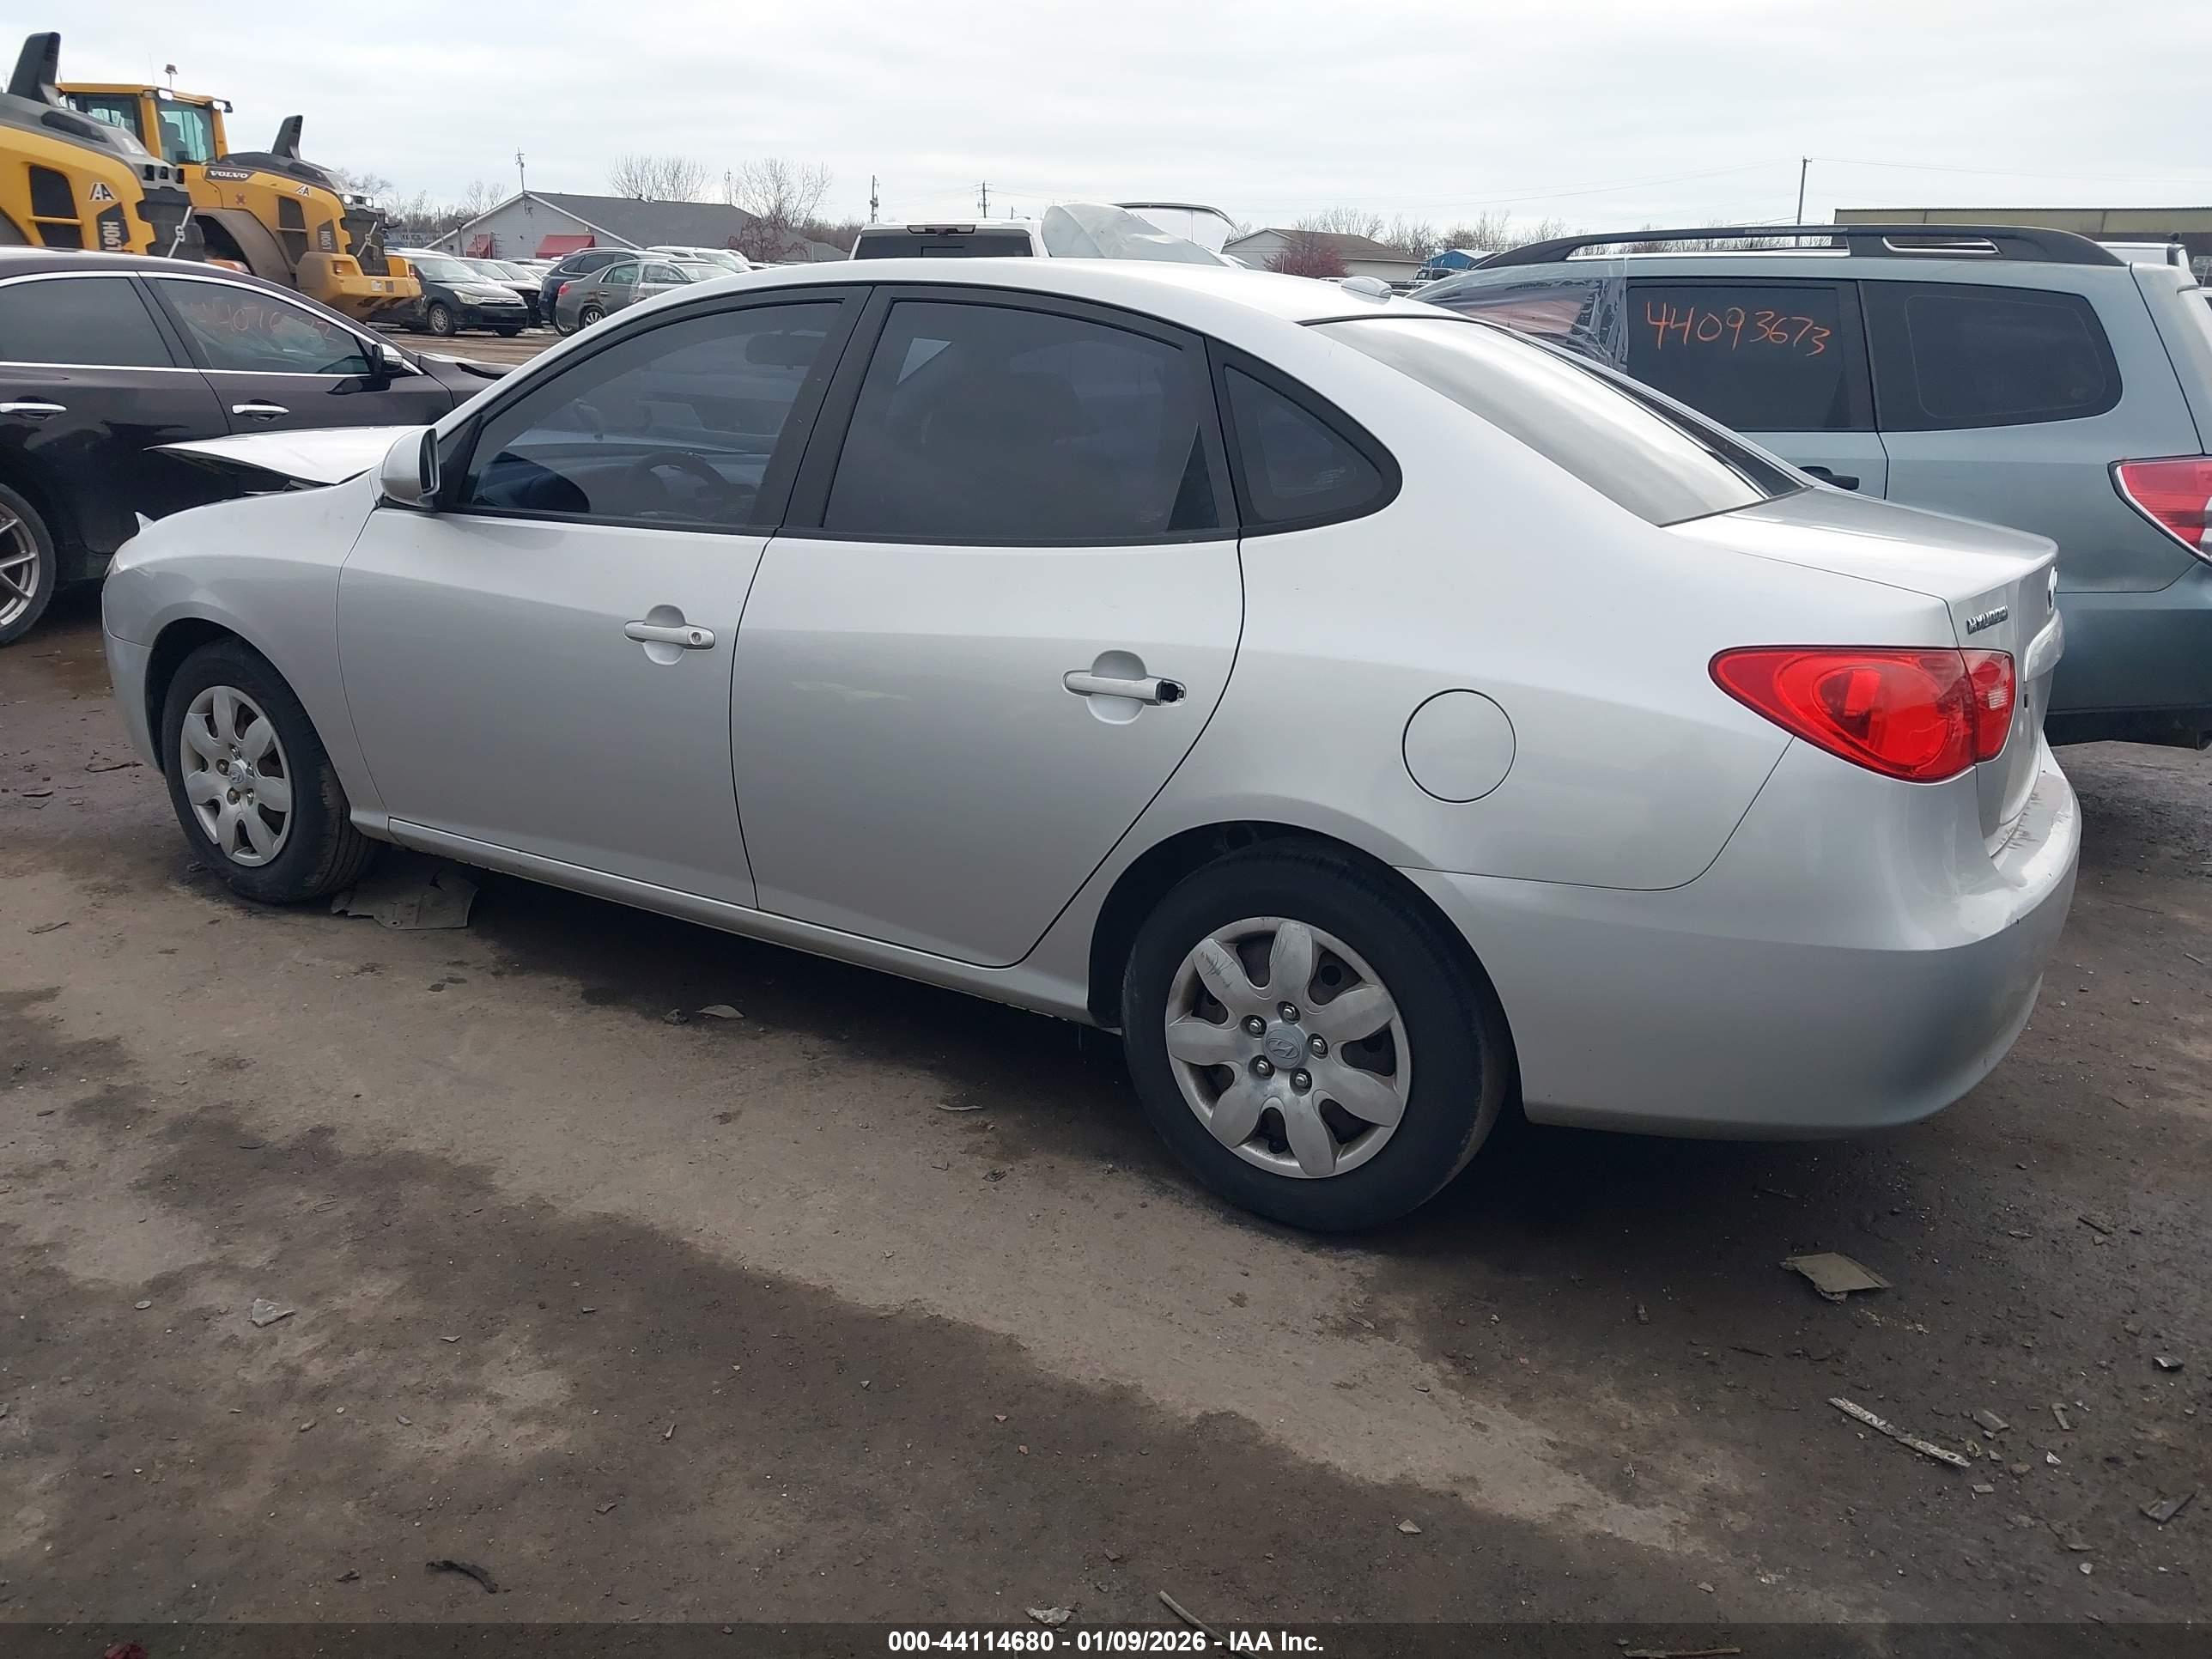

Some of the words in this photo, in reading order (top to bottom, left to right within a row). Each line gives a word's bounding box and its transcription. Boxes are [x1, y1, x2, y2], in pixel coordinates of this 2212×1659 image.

[210, 170, 248, 179] VOLVO
[101, 221, 122, 251] L90H
[1646, 301, 1832, 357] 44093673
